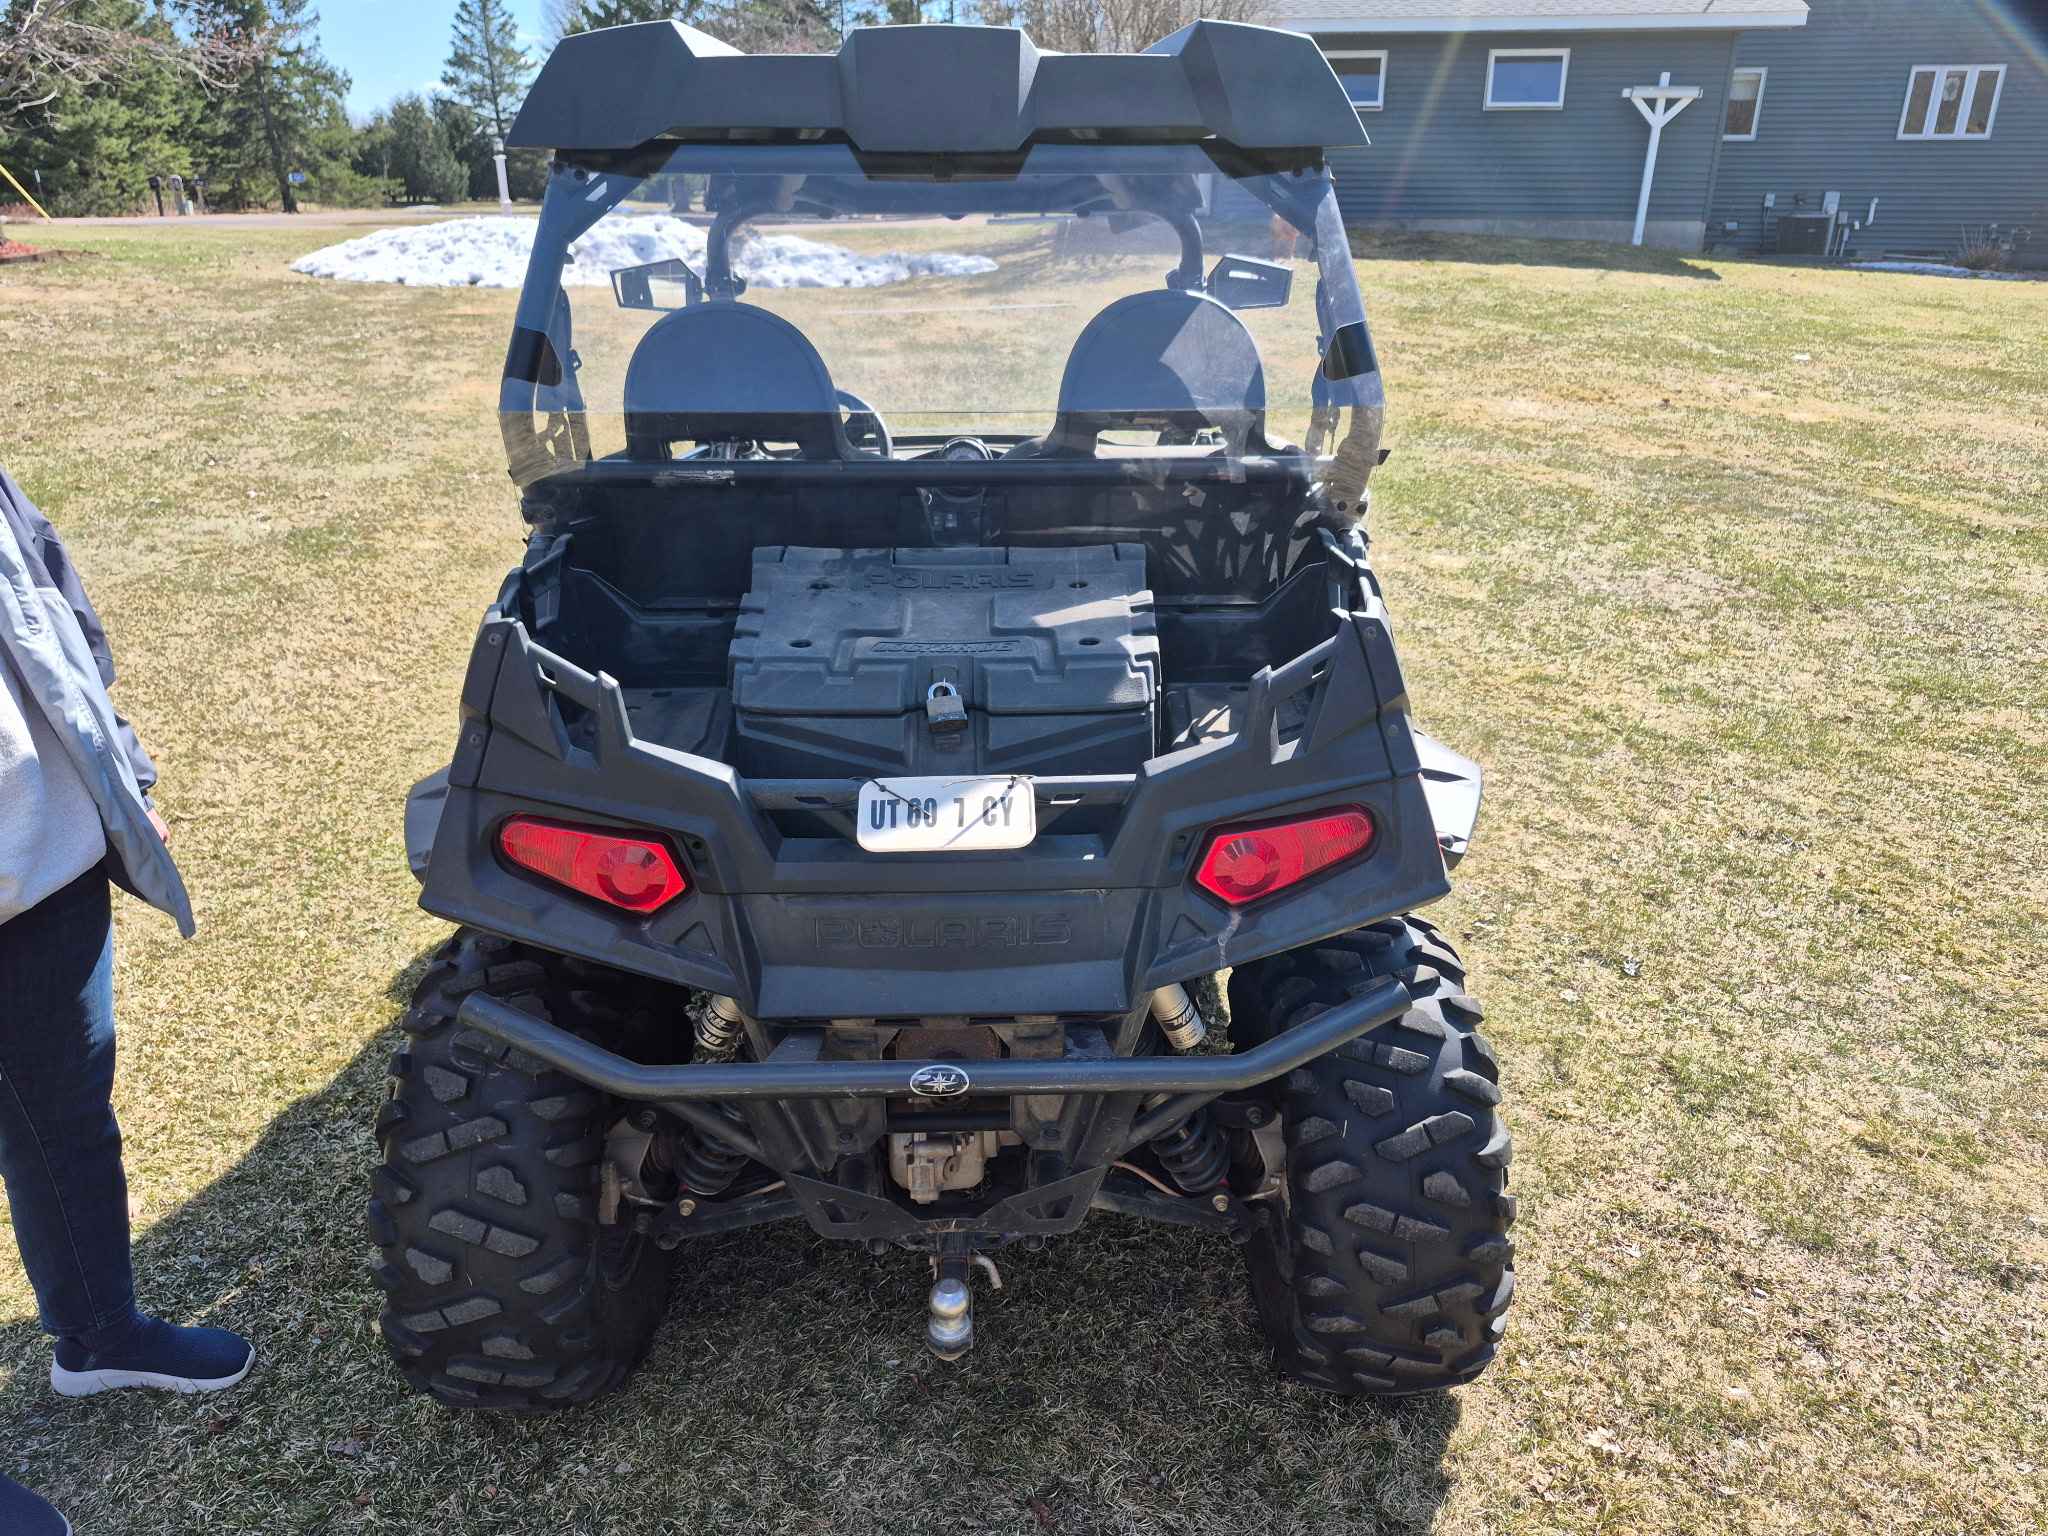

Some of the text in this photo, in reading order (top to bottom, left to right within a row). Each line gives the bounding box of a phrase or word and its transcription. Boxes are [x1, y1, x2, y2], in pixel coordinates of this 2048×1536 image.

[864, 571, 1035, 590] POLARIS
[870, 799, 900, 830] UT
[814, 911, 1072, 949] POLARIS
